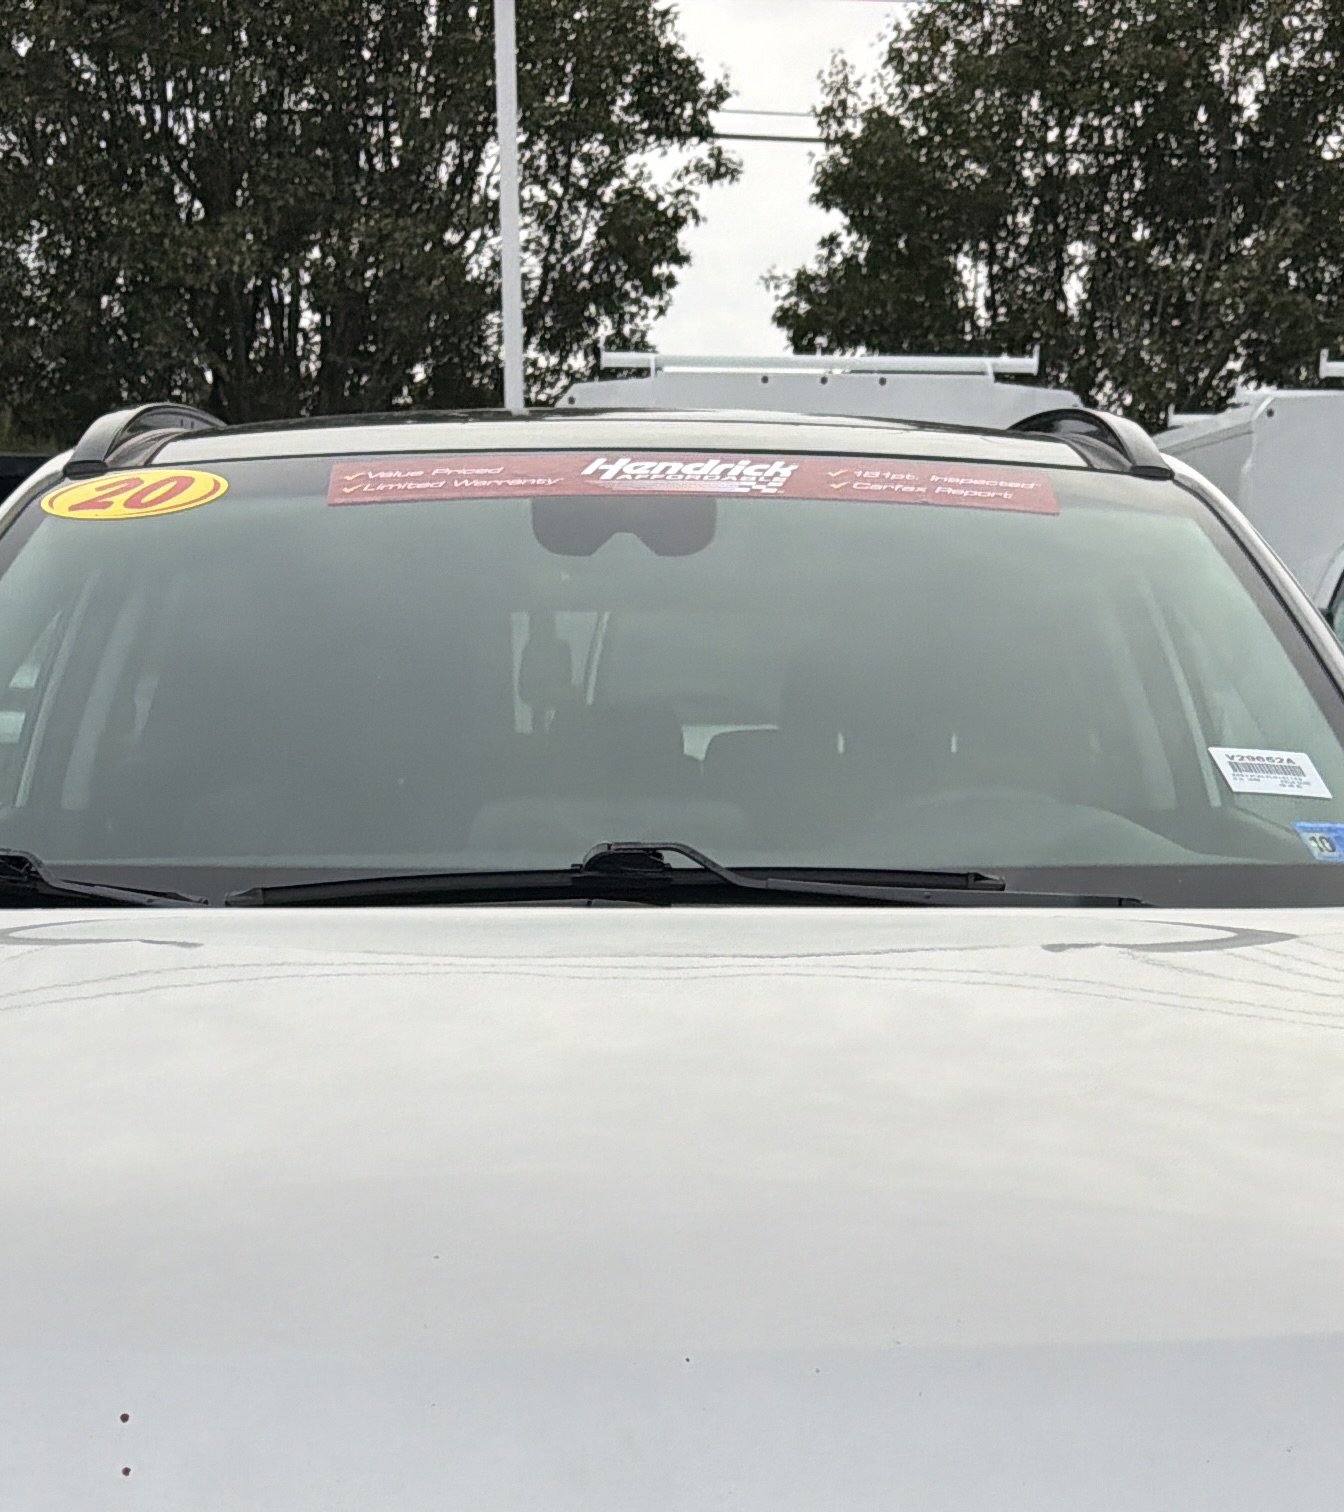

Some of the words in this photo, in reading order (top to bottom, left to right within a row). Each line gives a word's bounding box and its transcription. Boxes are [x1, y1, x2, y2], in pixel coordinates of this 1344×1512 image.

[368, 470, 425, 479] Value
[431, 466, 505, 476] Priced
[580, 457, 800, 481] Hendrick
[362, 480, 446, 492] Limited
[453, 477, 565, 487] Warranty
[616, 473, 788, 483] AFFORDABLE
[68, 476, 196, 512] 20
[852, 481, 927, 493] Carfax
[935, 486, 1014, 499] Report
